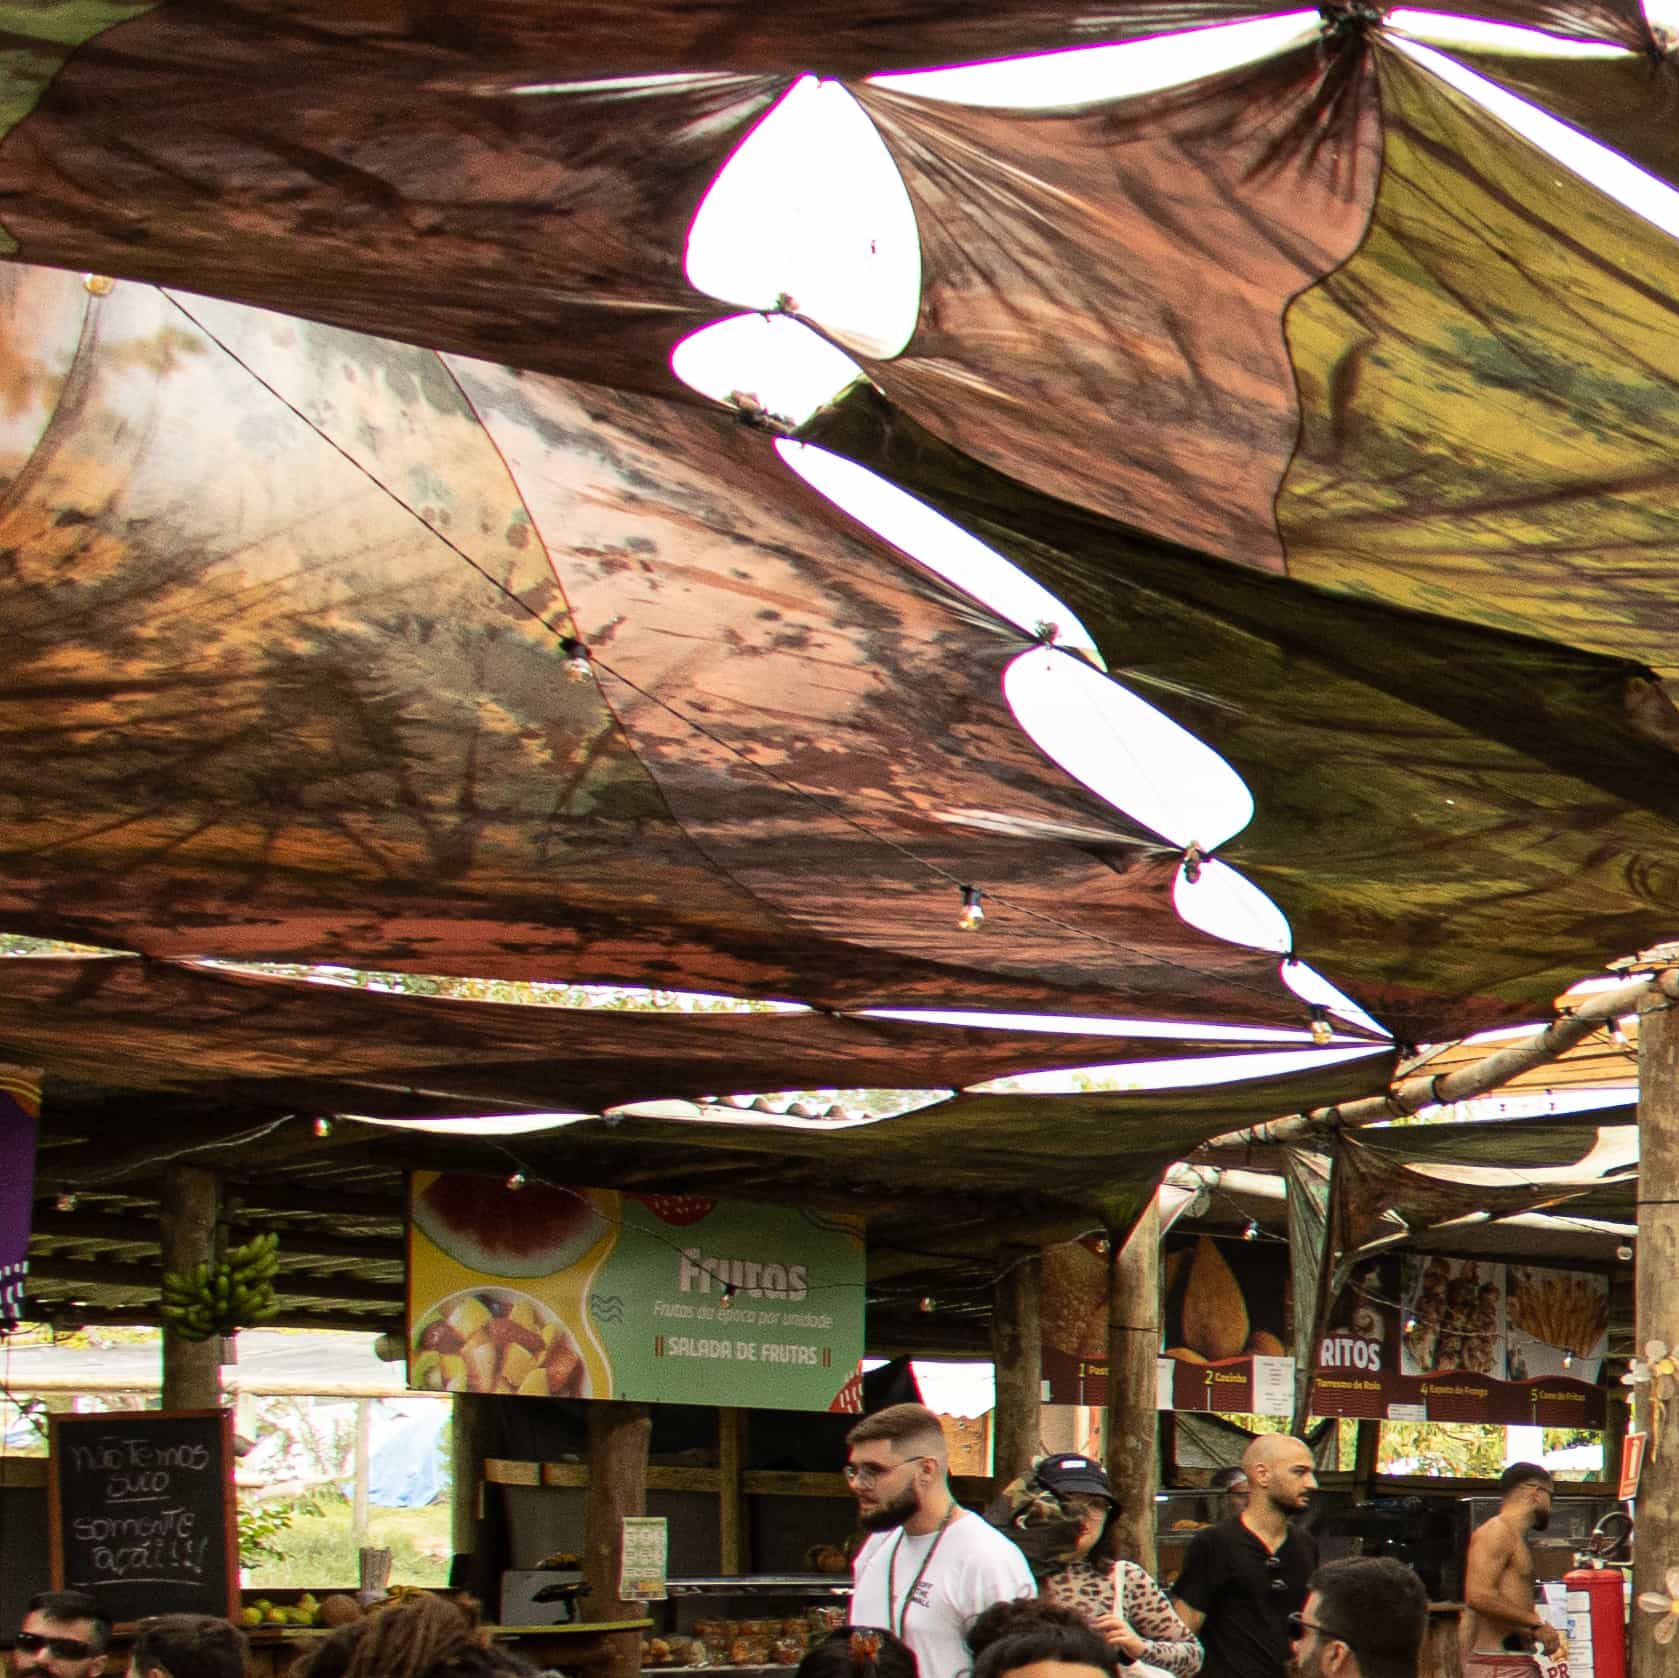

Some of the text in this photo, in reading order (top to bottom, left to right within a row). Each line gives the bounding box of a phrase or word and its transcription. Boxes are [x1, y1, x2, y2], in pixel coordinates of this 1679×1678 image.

[654, 1301, 694, 1319] Frutas
[783, 1312, 833, 1328] unidade
[668, 1337, 818, 1365] SALADA DE FRUTAS
[1320, 1338, 1381, 1371] RITOS
[1205, 1370, 1213, 1384] 2
[1530, 1388, 1538, 1401] 5
